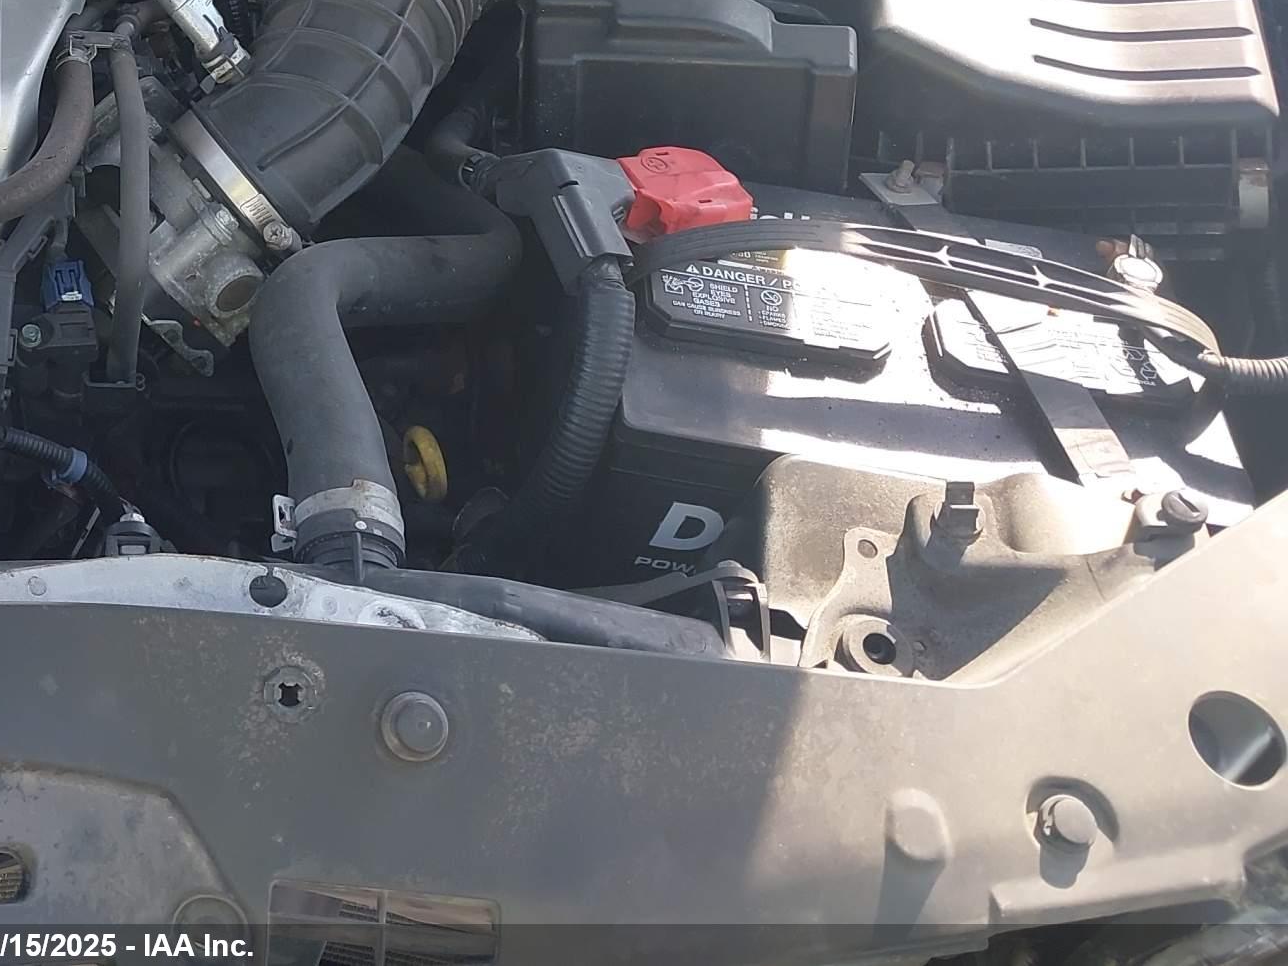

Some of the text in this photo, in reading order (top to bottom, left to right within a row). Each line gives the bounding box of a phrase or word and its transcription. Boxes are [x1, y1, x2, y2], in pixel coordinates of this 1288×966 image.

[702, 266, 765, 285] DANGER
[709, 283, 738, 293] SHIELD
[692, 291, 736, 304] EXPLOSIVE
[693, 298, 720, 307] GASES
[634, 555, 697, 574] POW
